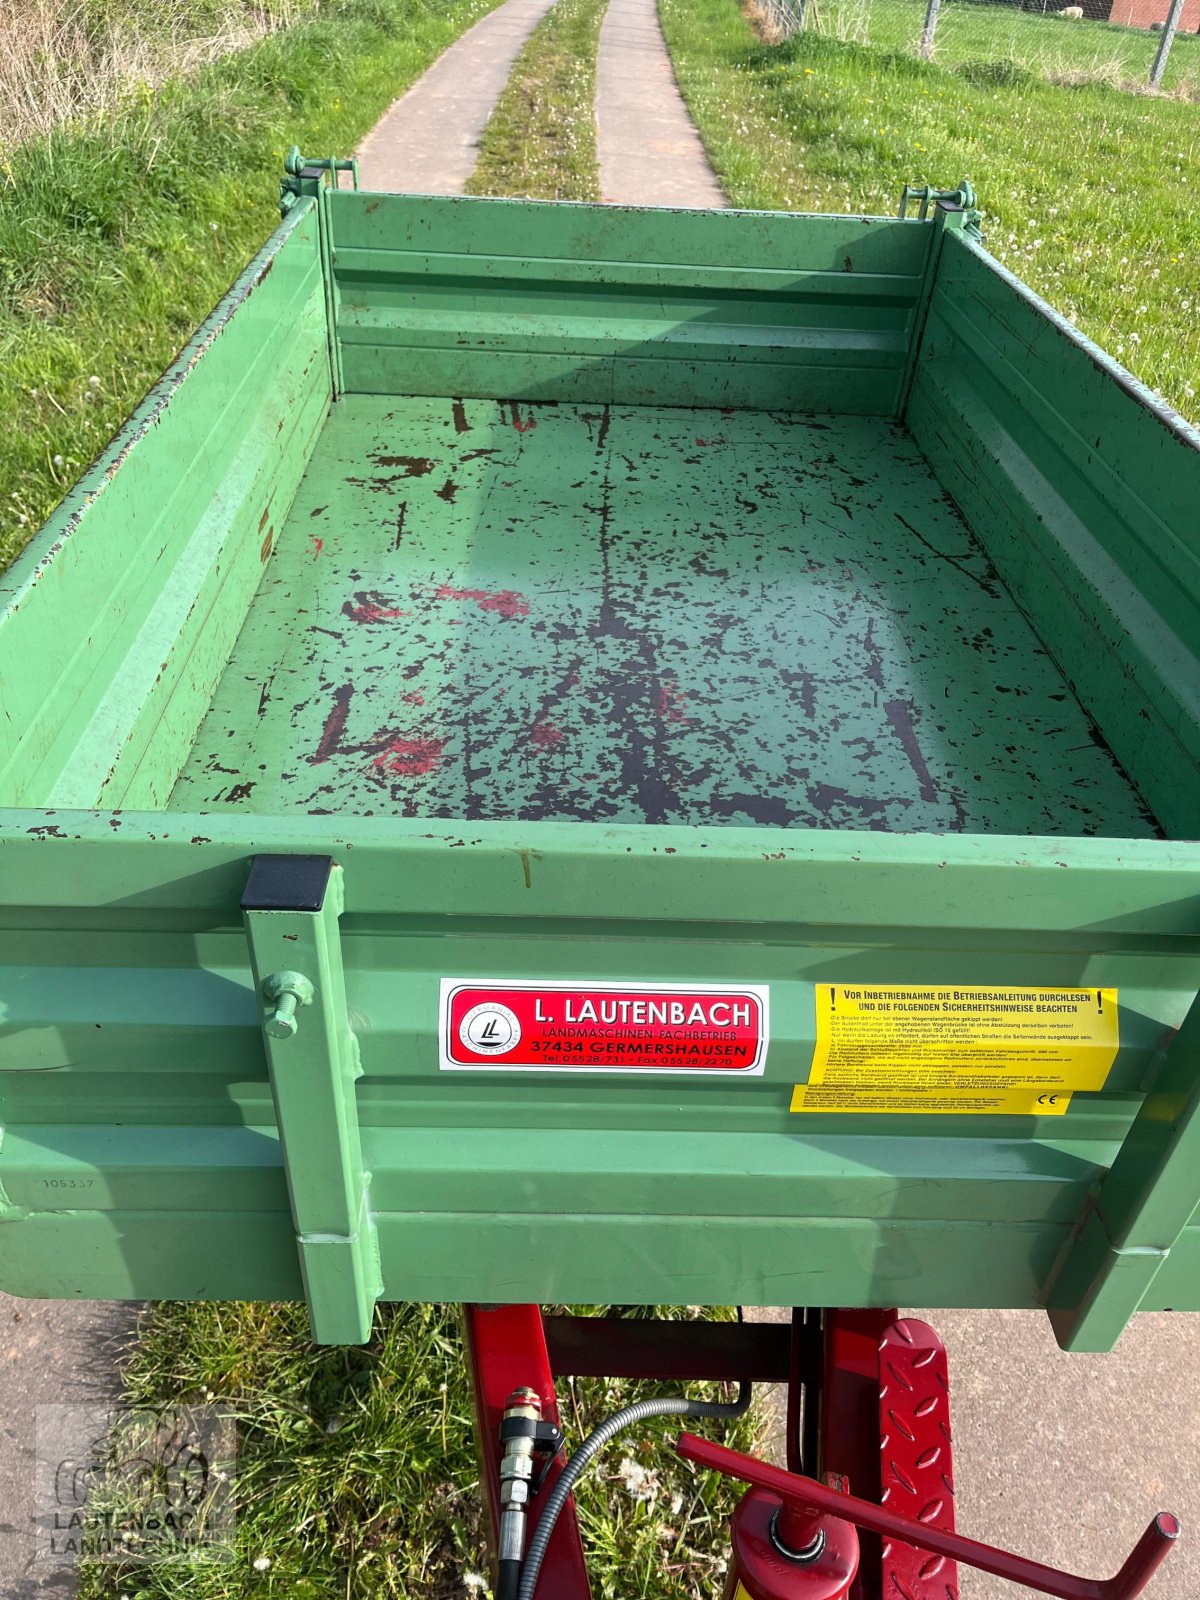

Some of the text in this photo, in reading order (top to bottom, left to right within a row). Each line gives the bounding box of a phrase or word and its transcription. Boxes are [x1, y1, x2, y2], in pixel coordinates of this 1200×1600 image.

[844, 990, 1091, 1002] VOR INBETRIEBNAHME DIE BETRIEBSANLEITUNG DURCHLESEN
[535, 998, 751, 1027] L. LAUTENBACH
[858, 1002, 1078, 1013] UND DIE FOLGENDEN SICHERHEITSHINWEISE BEACHTEN
[530, 1041, 747, 1056] 37434 GERMERSHAUSEN
[1038, 1094, 1059, 1105] CE
